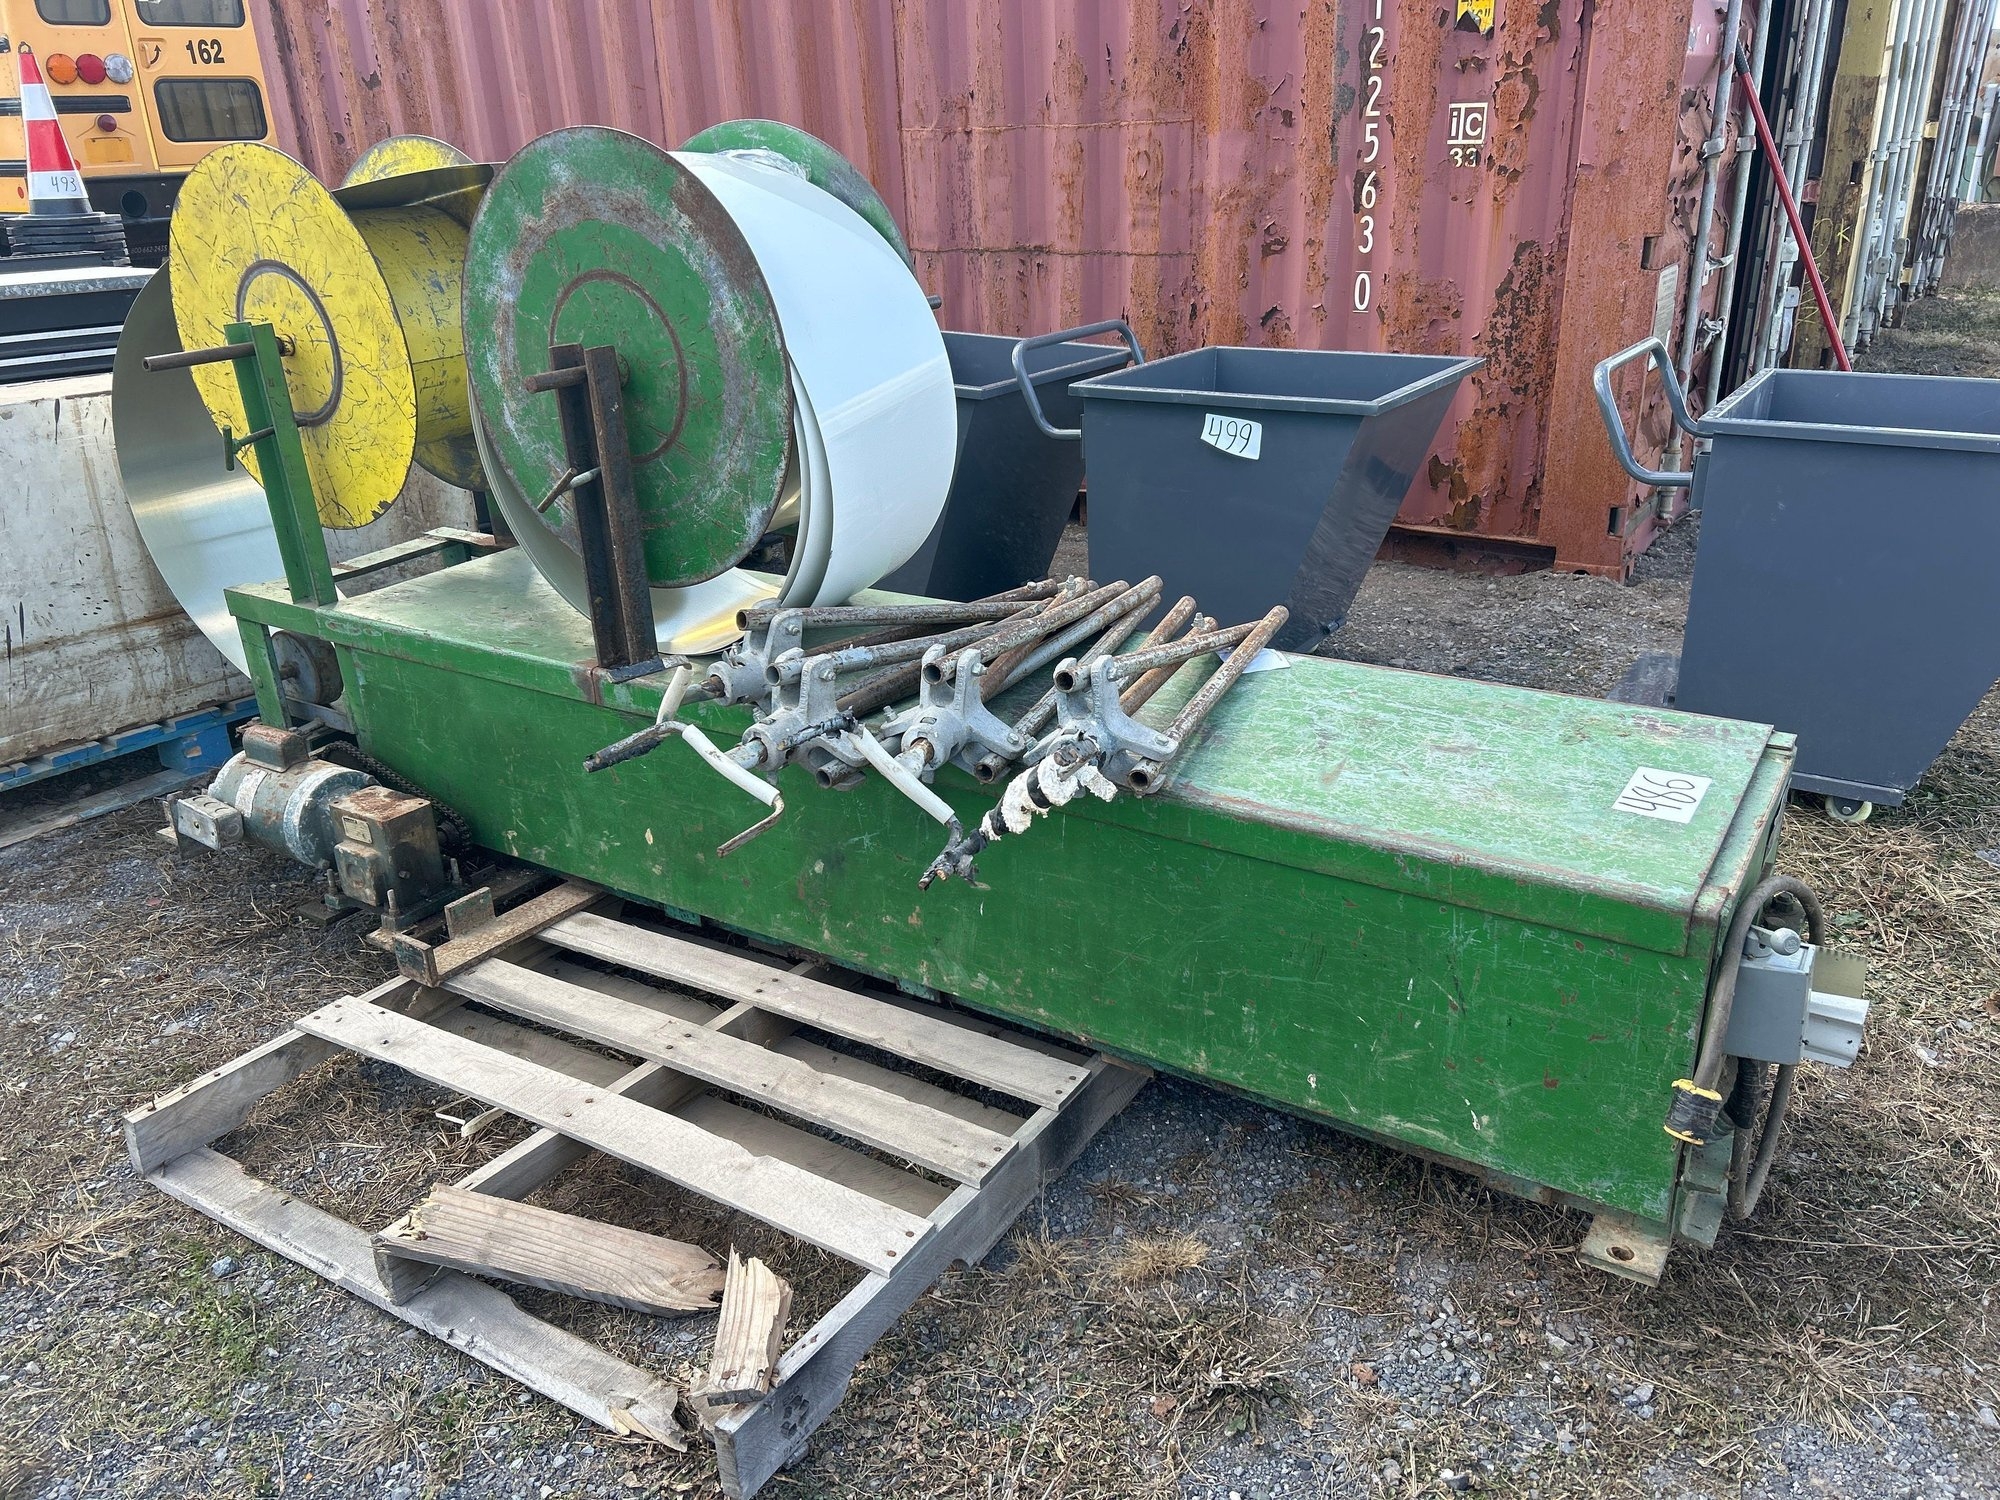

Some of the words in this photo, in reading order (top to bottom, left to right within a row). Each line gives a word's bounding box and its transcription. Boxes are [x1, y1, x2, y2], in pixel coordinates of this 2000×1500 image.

[185, 38, 225, 65] 162
[1449, 147, 1478, 168] 33
[51, 175, 77, 193] 493
[1208, 417, 1252, 454] 499
[1617, 774, 1697, 812] 486
